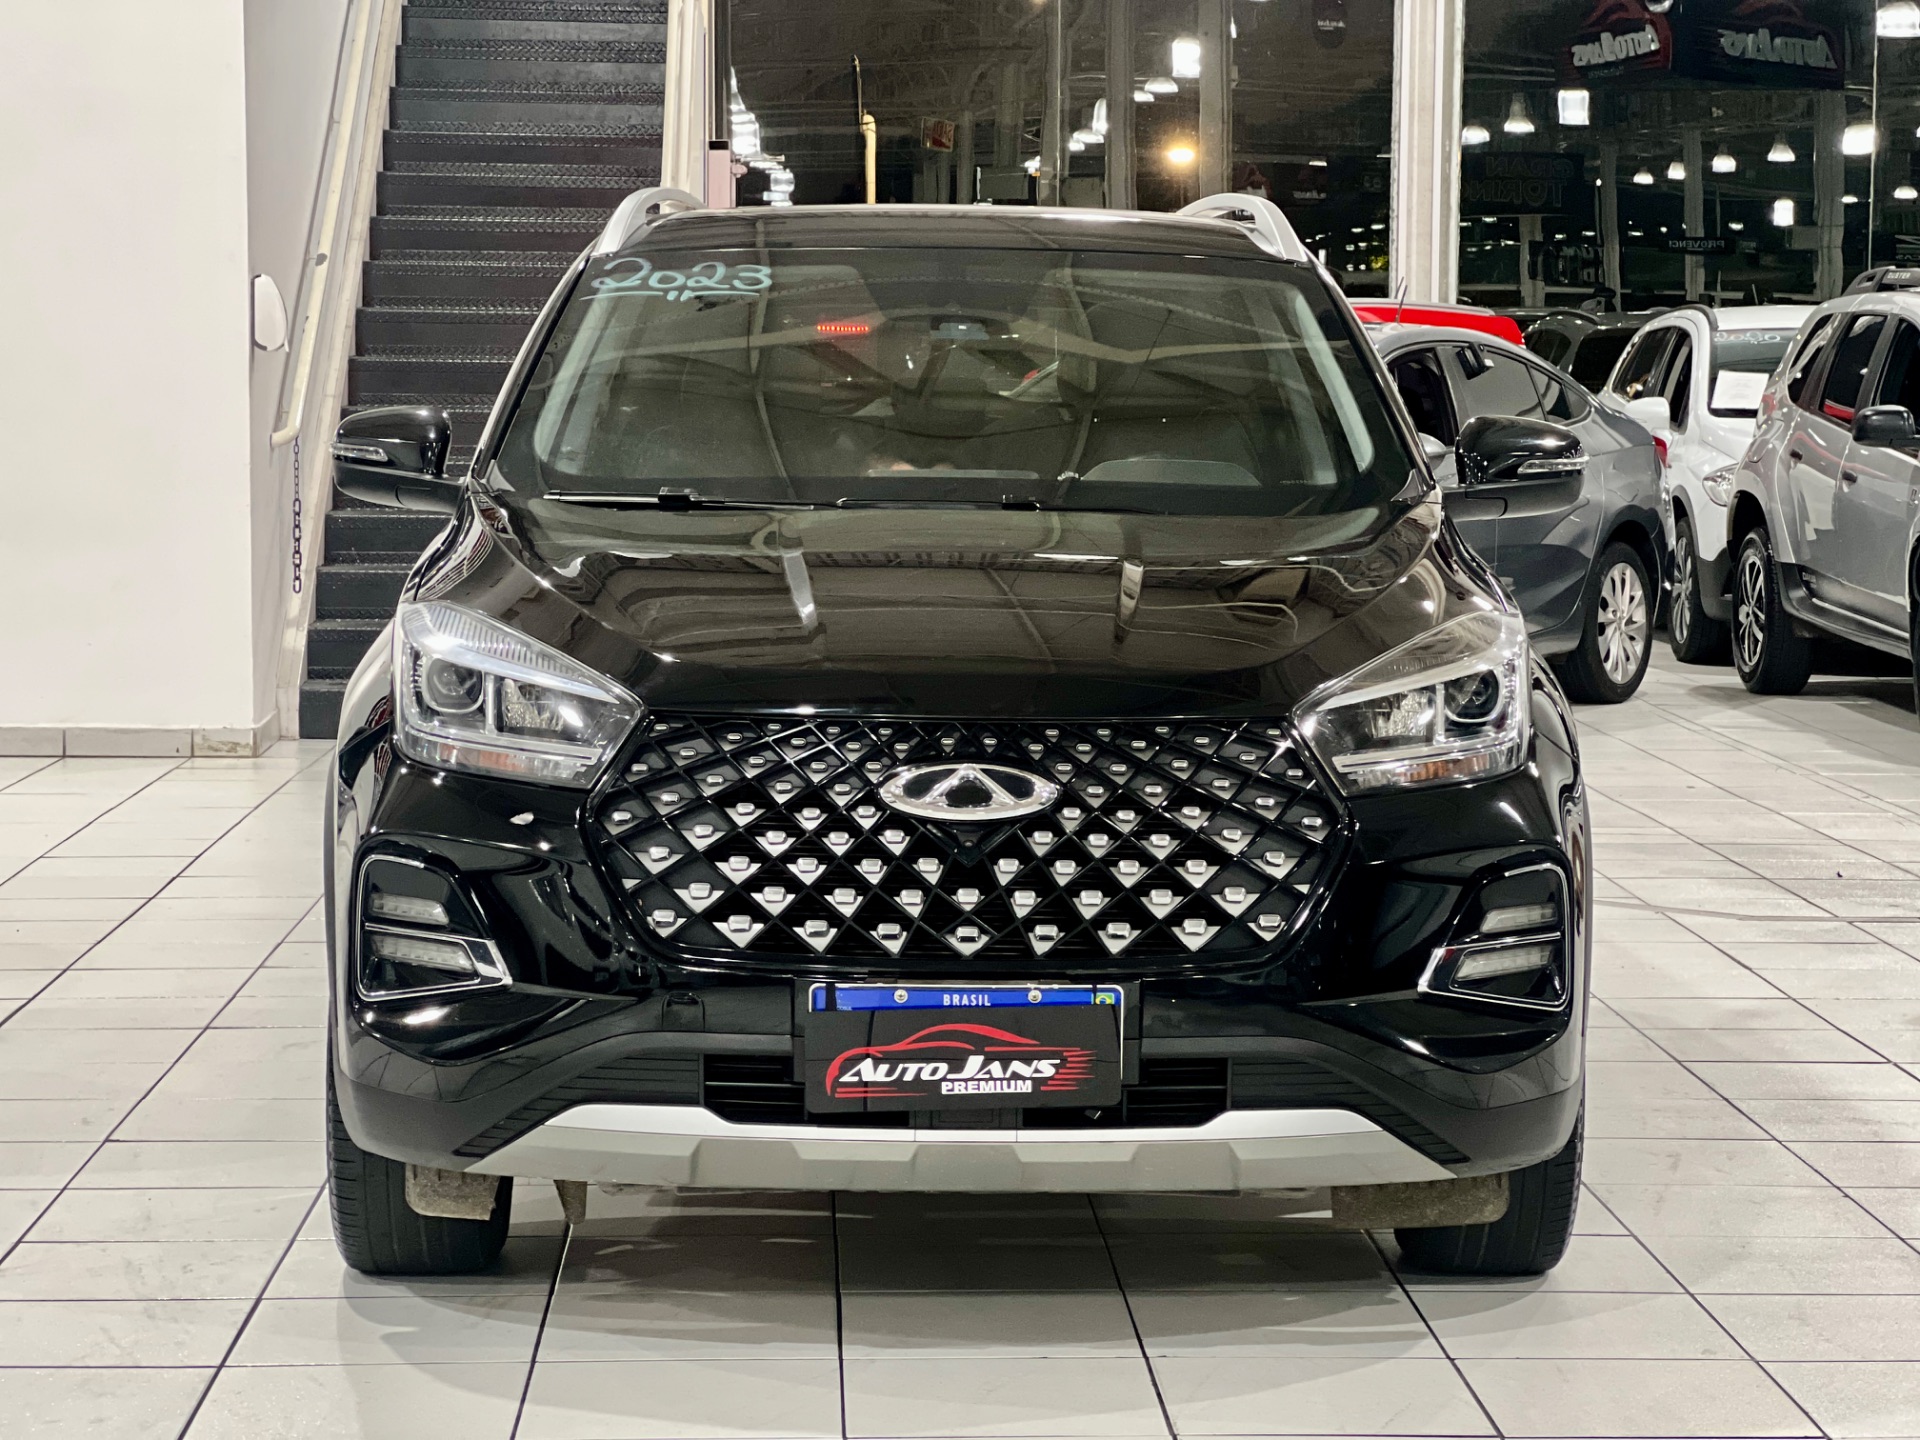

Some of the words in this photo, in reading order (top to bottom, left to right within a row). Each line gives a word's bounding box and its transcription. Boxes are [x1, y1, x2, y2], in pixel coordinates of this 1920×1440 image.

[591, 257, 772, 291] 2023
[943, 993, 991, 1007] BRASIL
[941, 1079, 1033, 1095] PREMIUM
